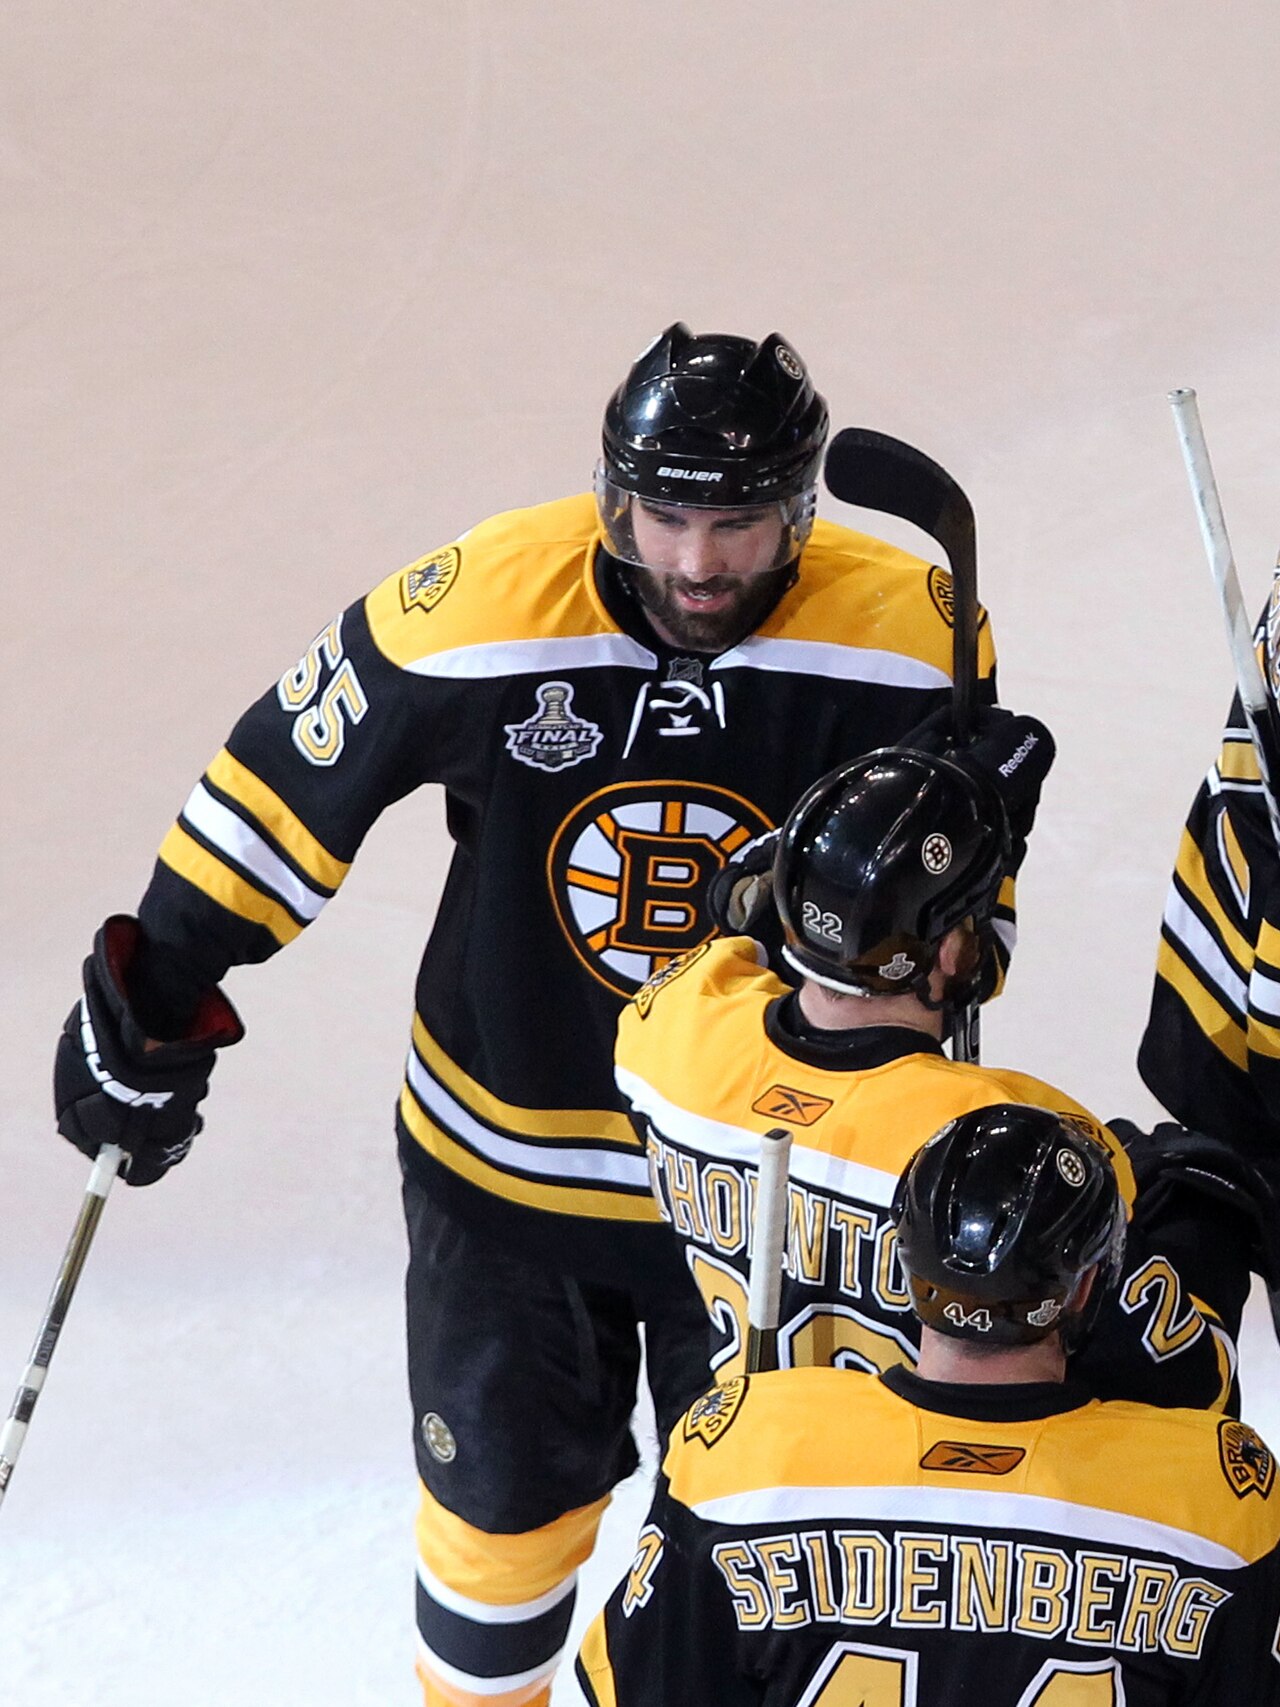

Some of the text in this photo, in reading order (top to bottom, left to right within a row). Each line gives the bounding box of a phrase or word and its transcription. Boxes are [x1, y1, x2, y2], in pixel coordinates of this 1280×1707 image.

[656, 466, 724, 482] BAUER
[277, 612, 369, 767] 55
[517, 729, 593, 744] FINAL
[998, 732, 1040, 778] Reebok
[802, 901, 843, 944] 22
[943, 1302, 993, 1332] 44
[711, 1530, 1235, 1660] SEIDENBERG
